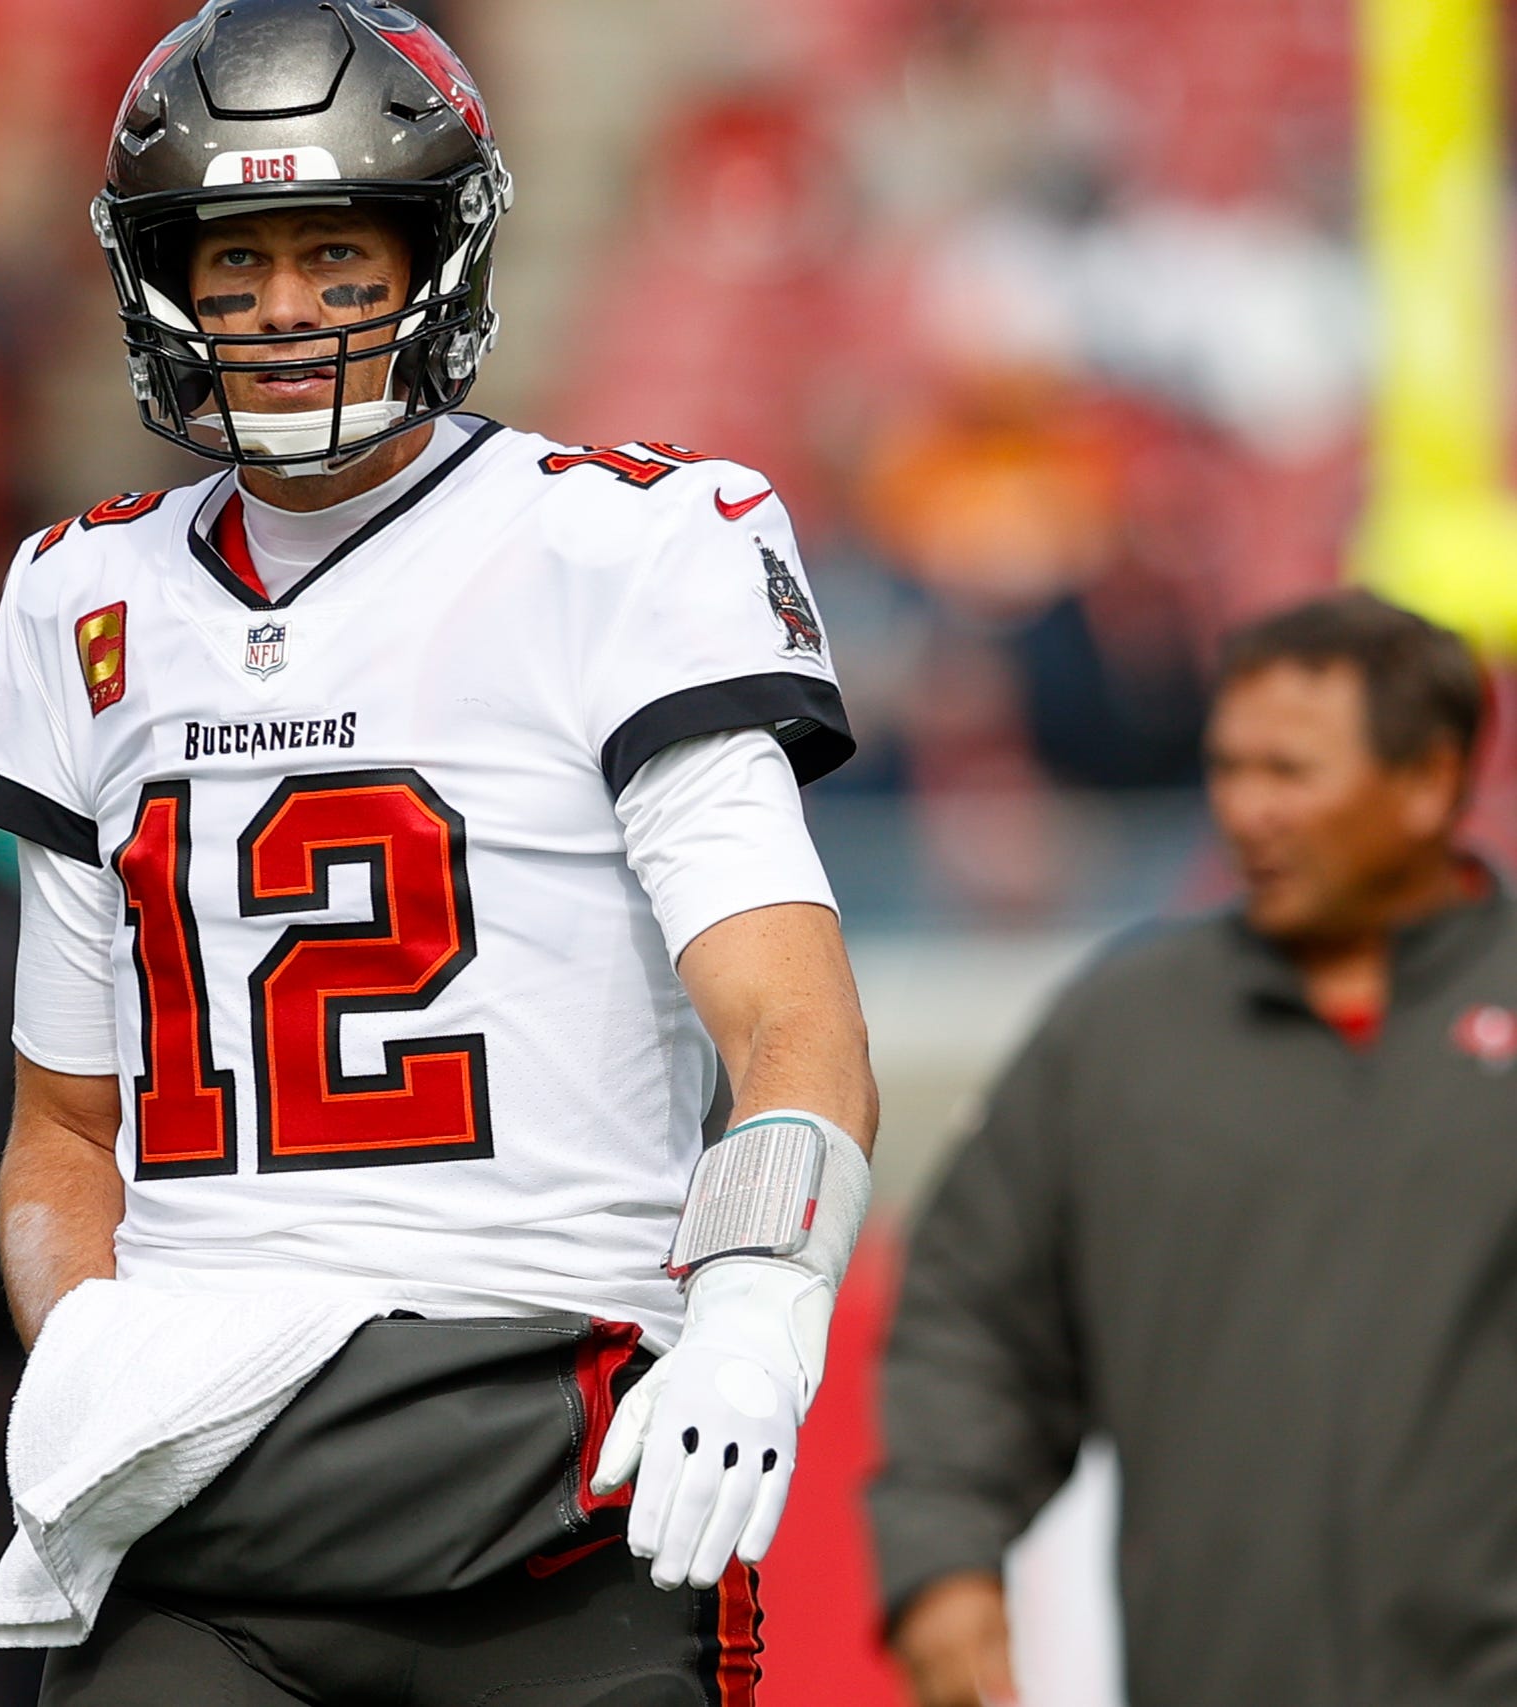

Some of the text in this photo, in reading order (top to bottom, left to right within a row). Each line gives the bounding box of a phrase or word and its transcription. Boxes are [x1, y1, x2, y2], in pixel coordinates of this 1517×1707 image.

[241, 154, 296, 183] BUCS
[78, 612, 121, 688] C
[248, 643, 280, 667] NFL
[185, 712, 357, 761] BUCCANEERS
[111, 768, 495, 1182] 12
